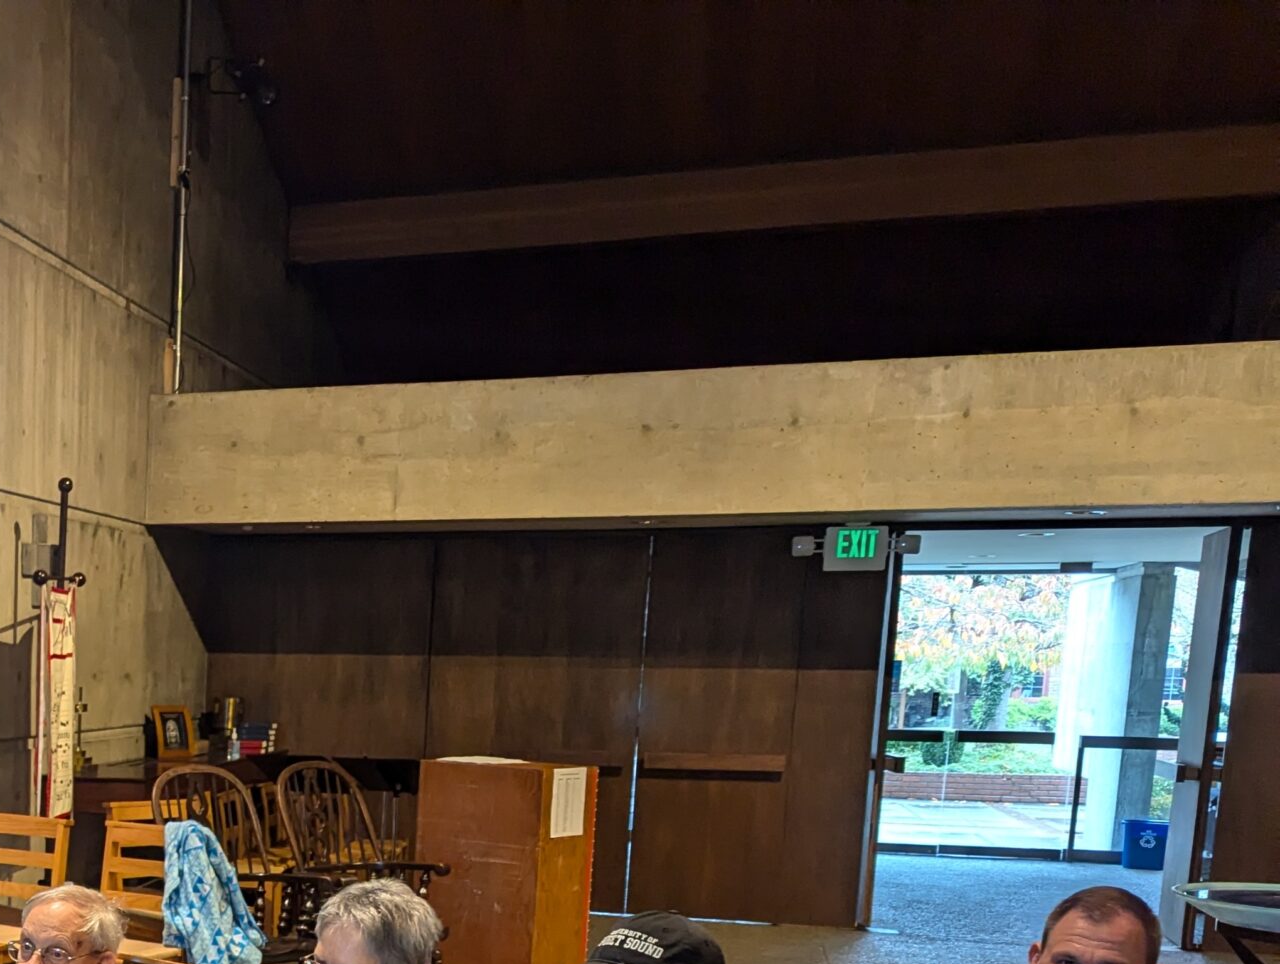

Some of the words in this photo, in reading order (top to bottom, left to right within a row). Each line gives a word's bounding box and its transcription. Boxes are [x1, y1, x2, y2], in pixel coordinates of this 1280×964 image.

[836, 529, 880, 559] EXIT
[623, 937, 664, 959] SOUND
[646, 936, 659, 944] OF
